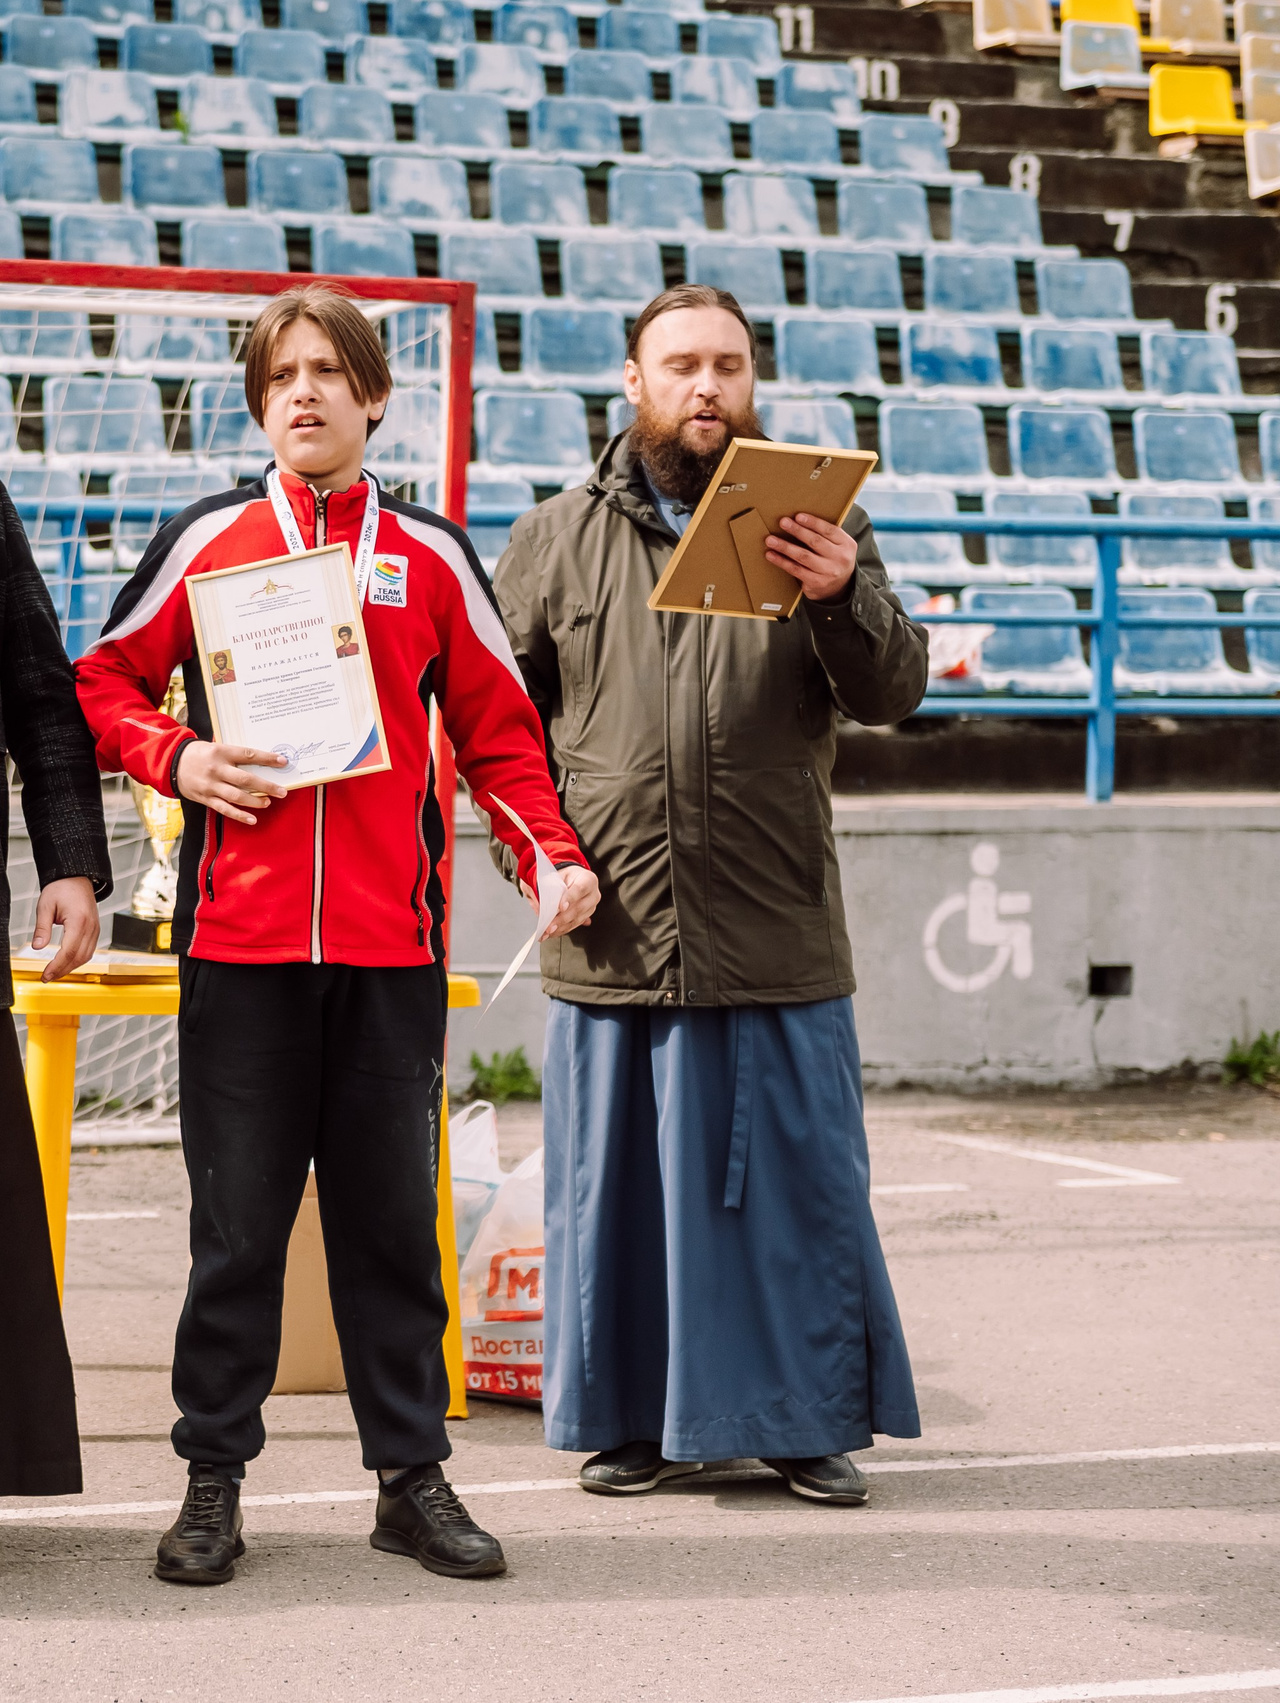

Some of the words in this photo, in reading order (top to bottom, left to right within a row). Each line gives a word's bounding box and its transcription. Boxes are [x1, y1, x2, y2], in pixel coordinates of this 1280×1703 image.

[773, 5, 814, 52] 11
[848, 57, 900, 100] 10
[928, 98, 960, 148] 9
[1009, 152, 1042, 198] 8
[1104, 210, 1135, 251] 7
[1205, 282, 1238, 337] 6
[373, 594, 403, 604] RUSSIA
[378, 588, 400, 596] TEAM
[251, 652, 319, 671] НАГРАЖДАЕТСЯ
[254, 632, 308, 650] ПИСЬМО
[428, 1108, 437, 1195] JORD
[496, 1370, 518, 1390] 15
